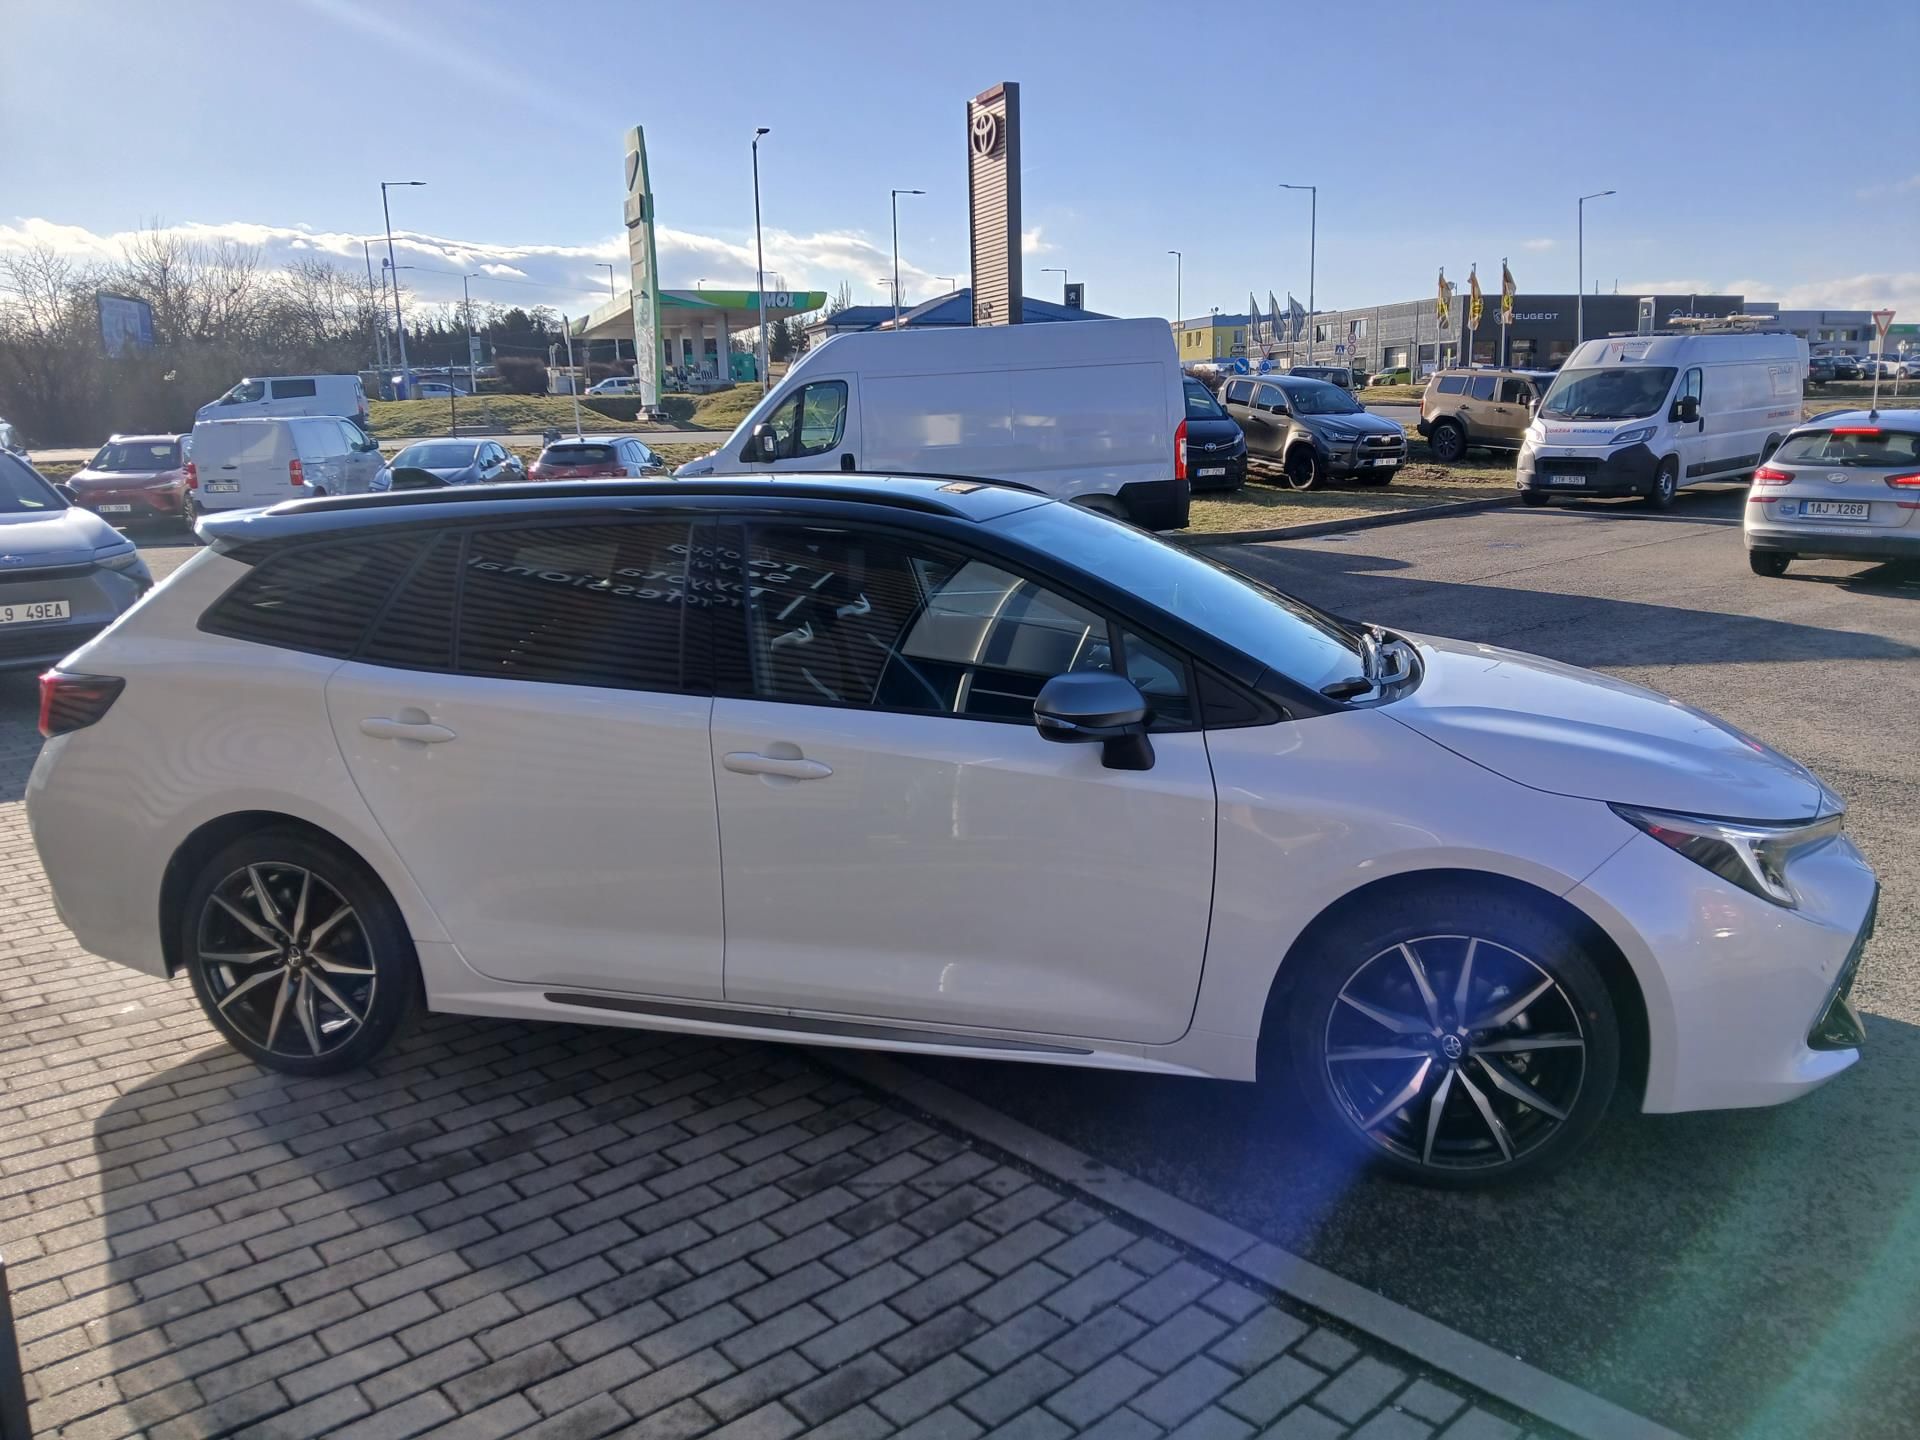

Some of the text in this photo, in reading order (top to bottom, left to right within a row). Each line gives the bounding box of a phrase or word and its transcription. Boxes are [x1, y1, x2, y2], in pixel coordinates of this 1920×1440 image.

[764, 292, 795, 308] MOL
[1810, 503, 1864, 515] 1AJ X268
[26, 603, 63, 619] 49EA
